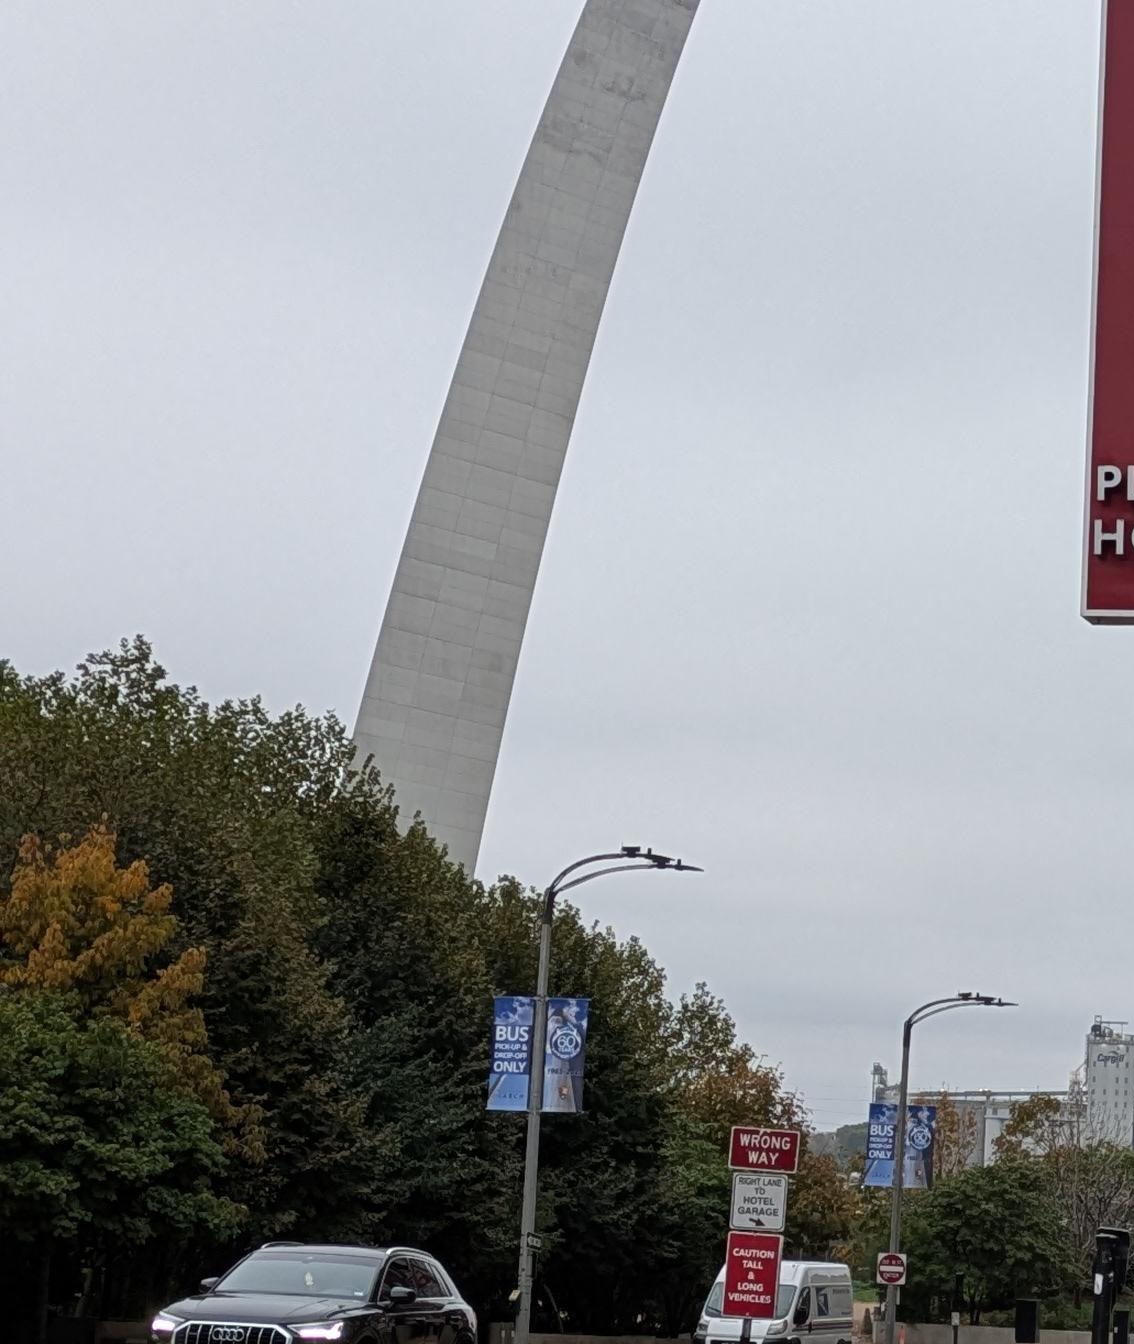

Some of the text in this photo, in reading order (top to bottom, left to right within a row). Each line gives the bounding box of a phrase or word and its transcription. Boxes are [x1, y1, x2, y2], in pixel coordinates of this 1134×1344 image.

[495, 1025, 529, 1041] BUS
[557, 1035, 576, 1048] 60
[493, 1061, 527, 1072] ONLY
[870, 1124, 894, 1136] BUS
[740, 1133, 791, 1150] WRONG
[748, 1151, 779, 1165] WAY
[868, 1150, 892, 1159] ONLY
[738, 1177, 782, 1187] RIGHT LANE
[754, 1187, 766, 1195] TO
[743, 1196, 775, 1206] HOTEL
[737, 1206, 780, 1217] GARAGE
[733, 1248, 775, 1259] CAUTION
[742, 1260, 763, 1270] TALL
[747, 1271, 755, 1280] &
[737, 1282, 764, 1292] LONG
[728, 1292, 771, 1304] VEHICLES
